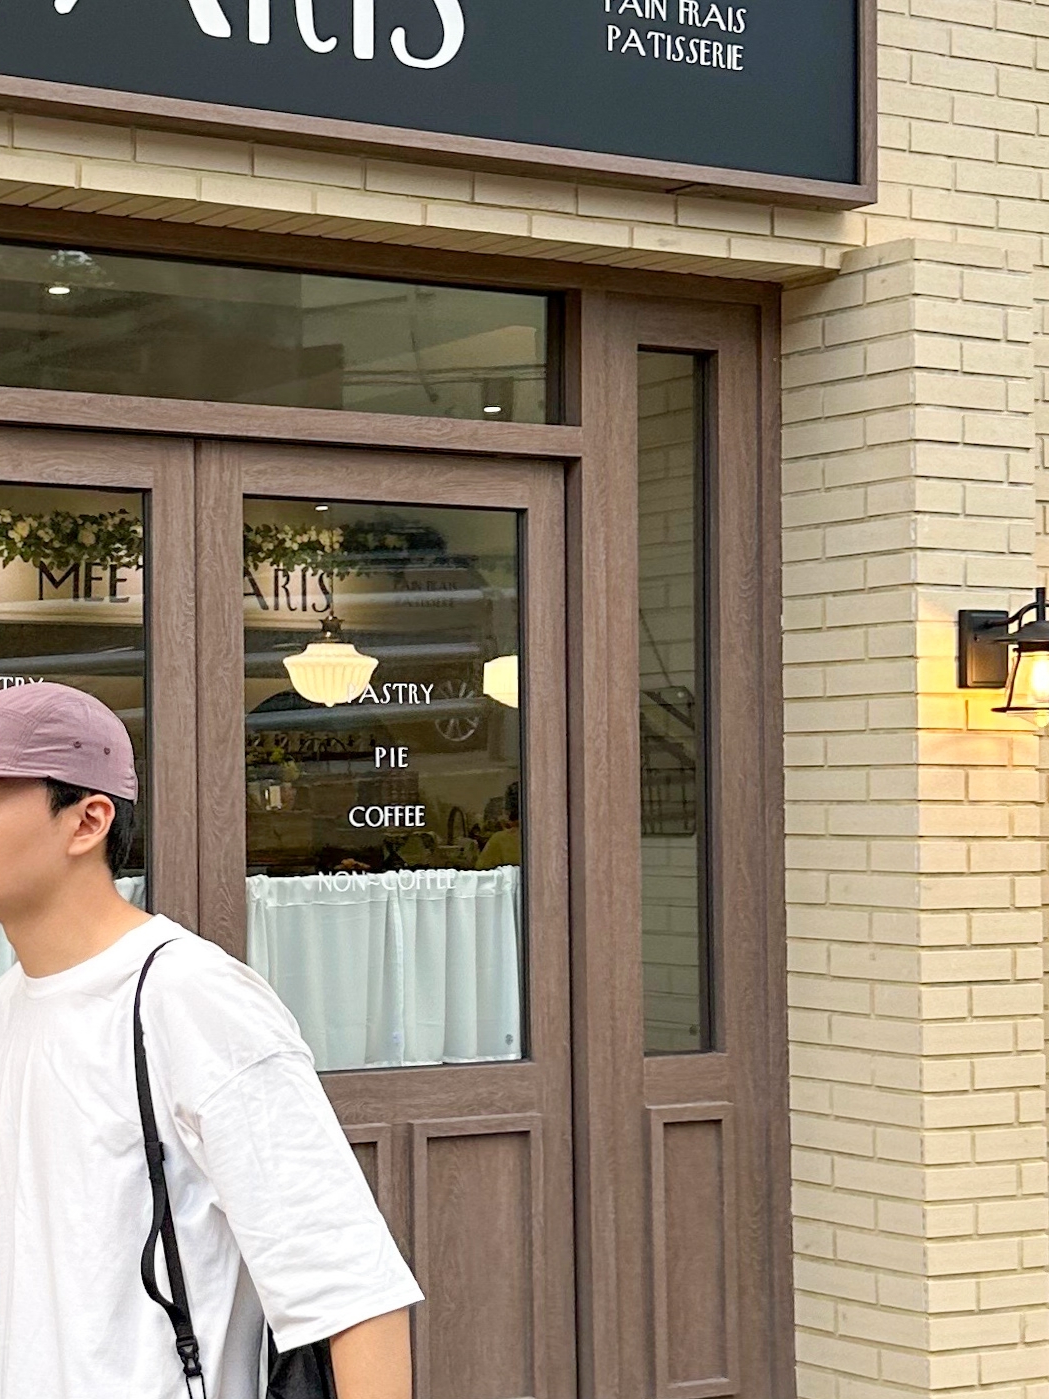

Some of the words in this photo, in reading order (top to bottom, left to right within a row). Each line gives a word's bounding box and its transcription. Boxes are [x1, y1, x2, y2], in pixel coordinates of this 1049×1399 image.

[678, 0, 747, 33] FRAIS
[607, 24, 744, 71] PATISSERIE
[347, 683, 434, 705] PASTRY
[374, 746, 409, 769] PIE
[348, 805, 426, 828] COFFEE
